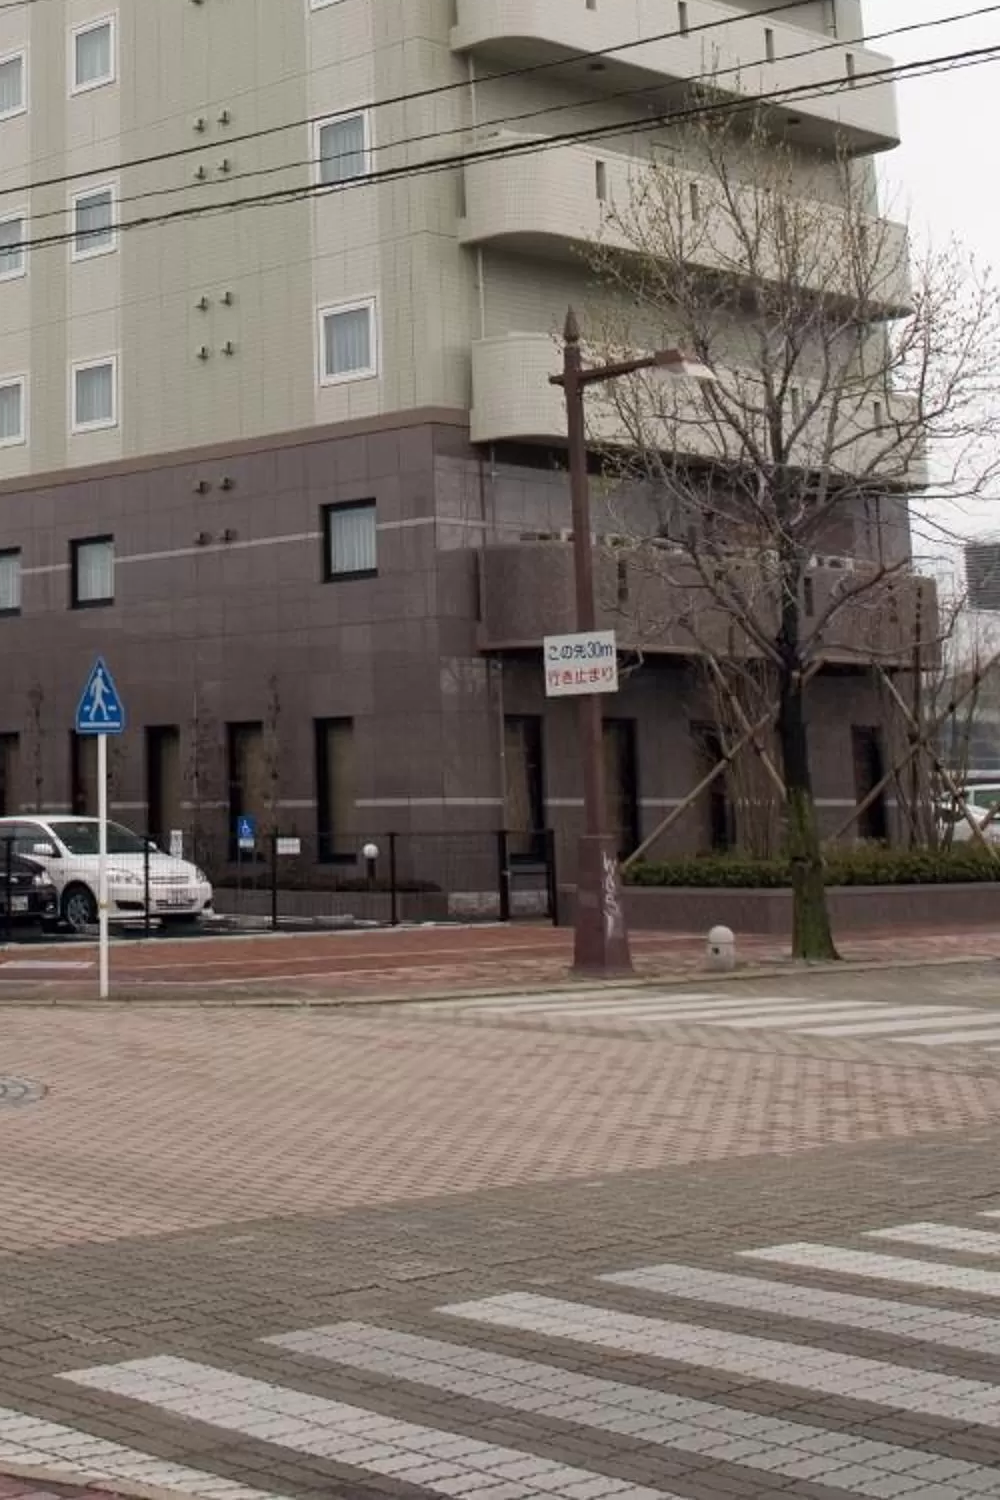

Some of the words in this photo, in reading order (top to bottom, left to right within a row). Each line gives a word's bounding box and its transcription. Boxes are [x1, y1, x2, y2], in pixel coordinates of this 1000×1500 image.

[548, 641, 613, 660] この先30m
[548, 666, 614, 687] 行き止まり
